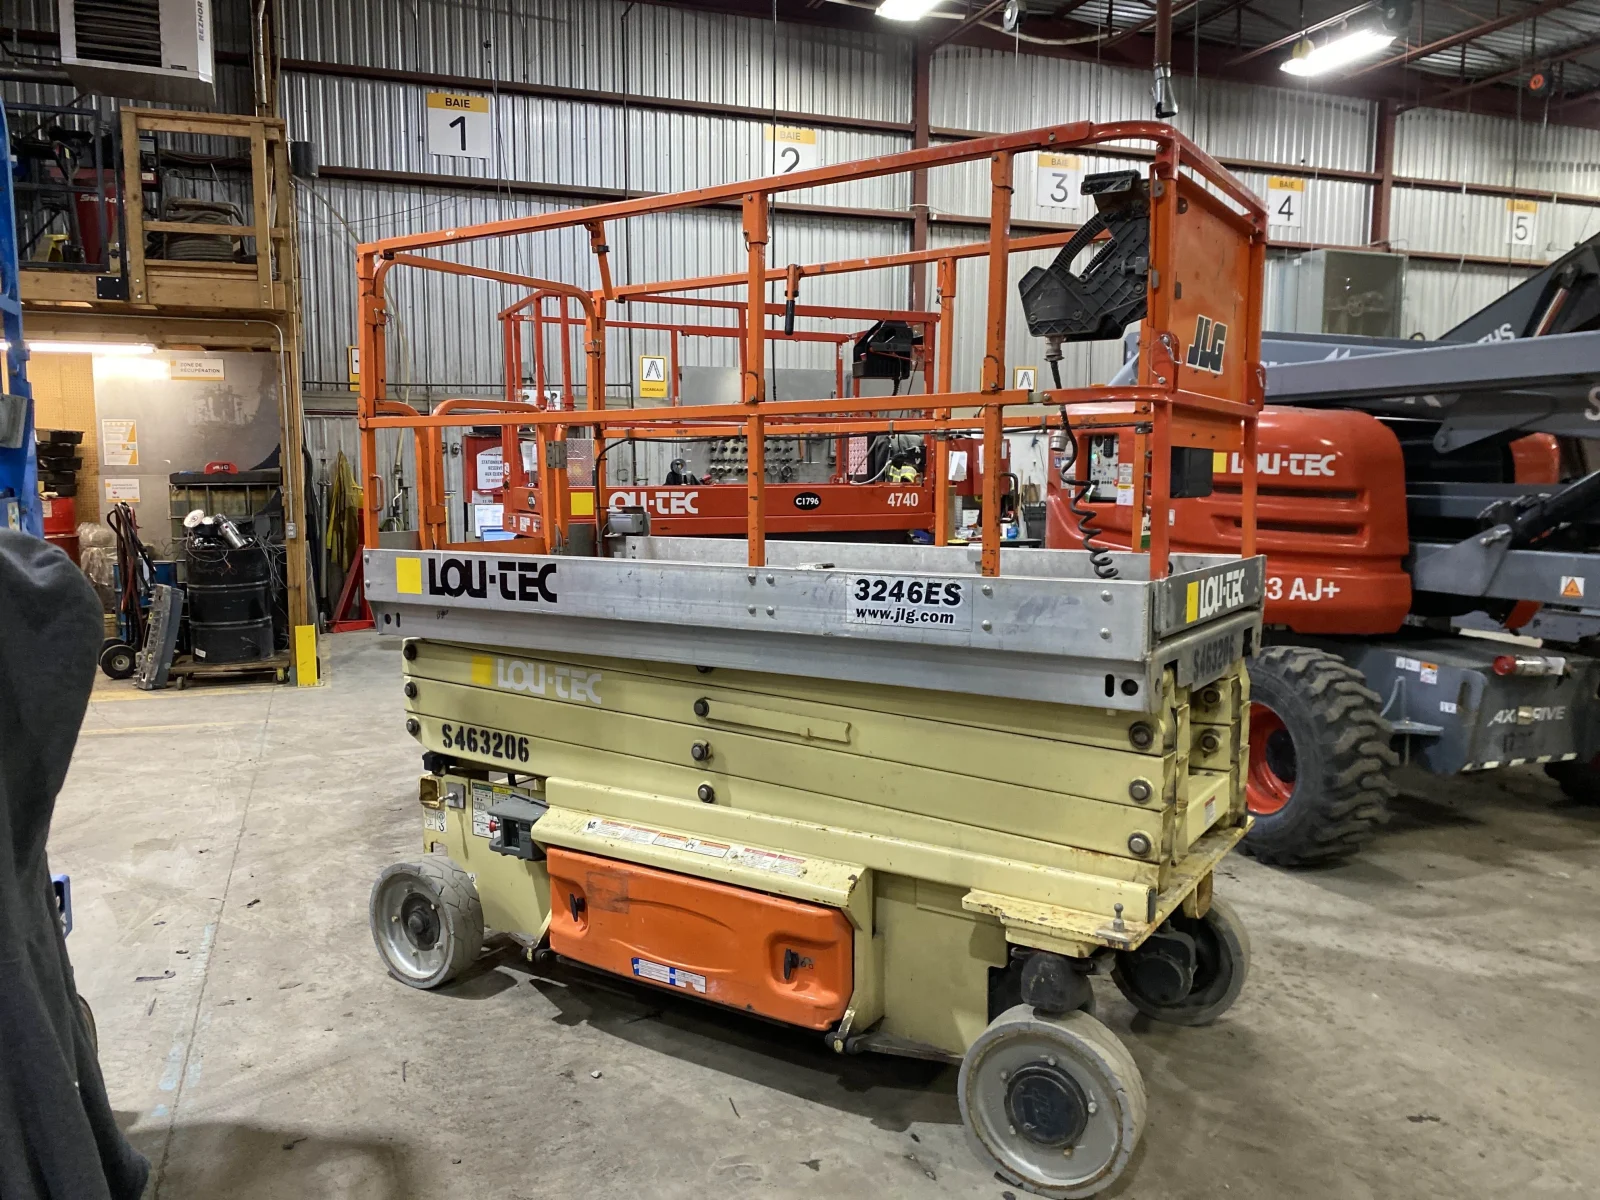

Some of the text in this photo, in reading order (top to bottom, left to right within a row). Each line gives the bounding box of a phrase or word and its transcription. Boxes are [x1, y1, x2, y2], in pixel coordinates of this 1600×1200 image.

[445, 97, 471, 108] BAIE
[449, 115, 466, 151] 1
[780, 130, 801, 141] BAIE
[781, 146, 800, 174] 2
[1051, 158, 1068, 167] BAIE
[1050, 172, 1068, 203] 3
[1279, 180, 1295, 189] BAIE
[1277, 194, 1294, 221] 4
[1515, 215, 1529, 240] 5
[1186, 314, 1228, 375] JLG
[608, 491, 699, 514] OU-TEC
[887, 492, 919, 507] 4740
[428, 557, 557, 603] LOU-TEC
[854, 578, 962, 606] 3246ES
[1289, 577, 1341, 601] AJ+
[855, 606, 954, 624] www.jlg.com
[497, 658, 602, 704] LOU-TEC
[441, 723, 530, 763] S463206
